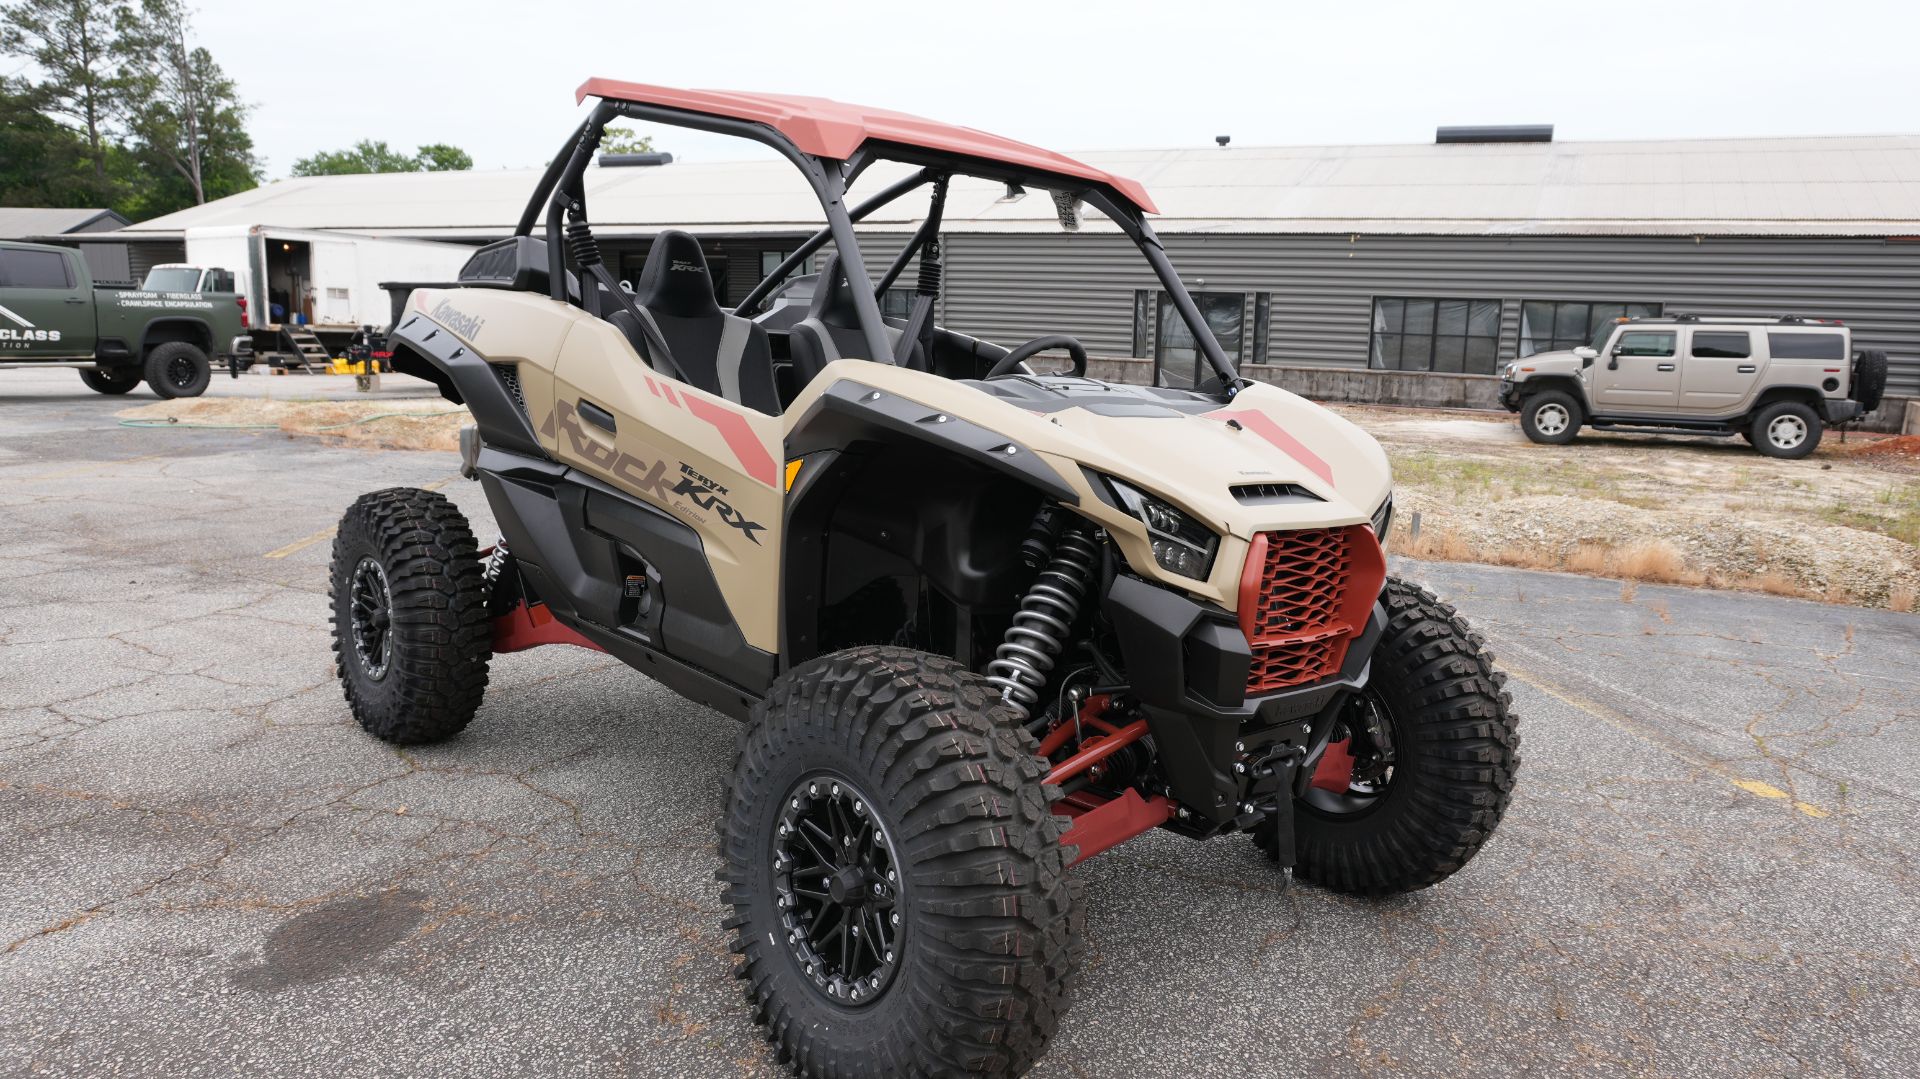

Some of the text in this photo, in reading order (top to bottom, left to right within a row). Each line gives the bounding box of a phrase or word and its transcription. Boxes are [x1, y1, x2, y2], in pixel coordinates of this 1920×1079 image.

[119, 291, 203, 300] SPRAYFOAM FIBERGLASS
[121, 300, 214, 309] CRAWLSPACE ENCAPSULATION
[430, 297, 486, 342] Kawasaki
[671, 475, 768, 547] KRX
